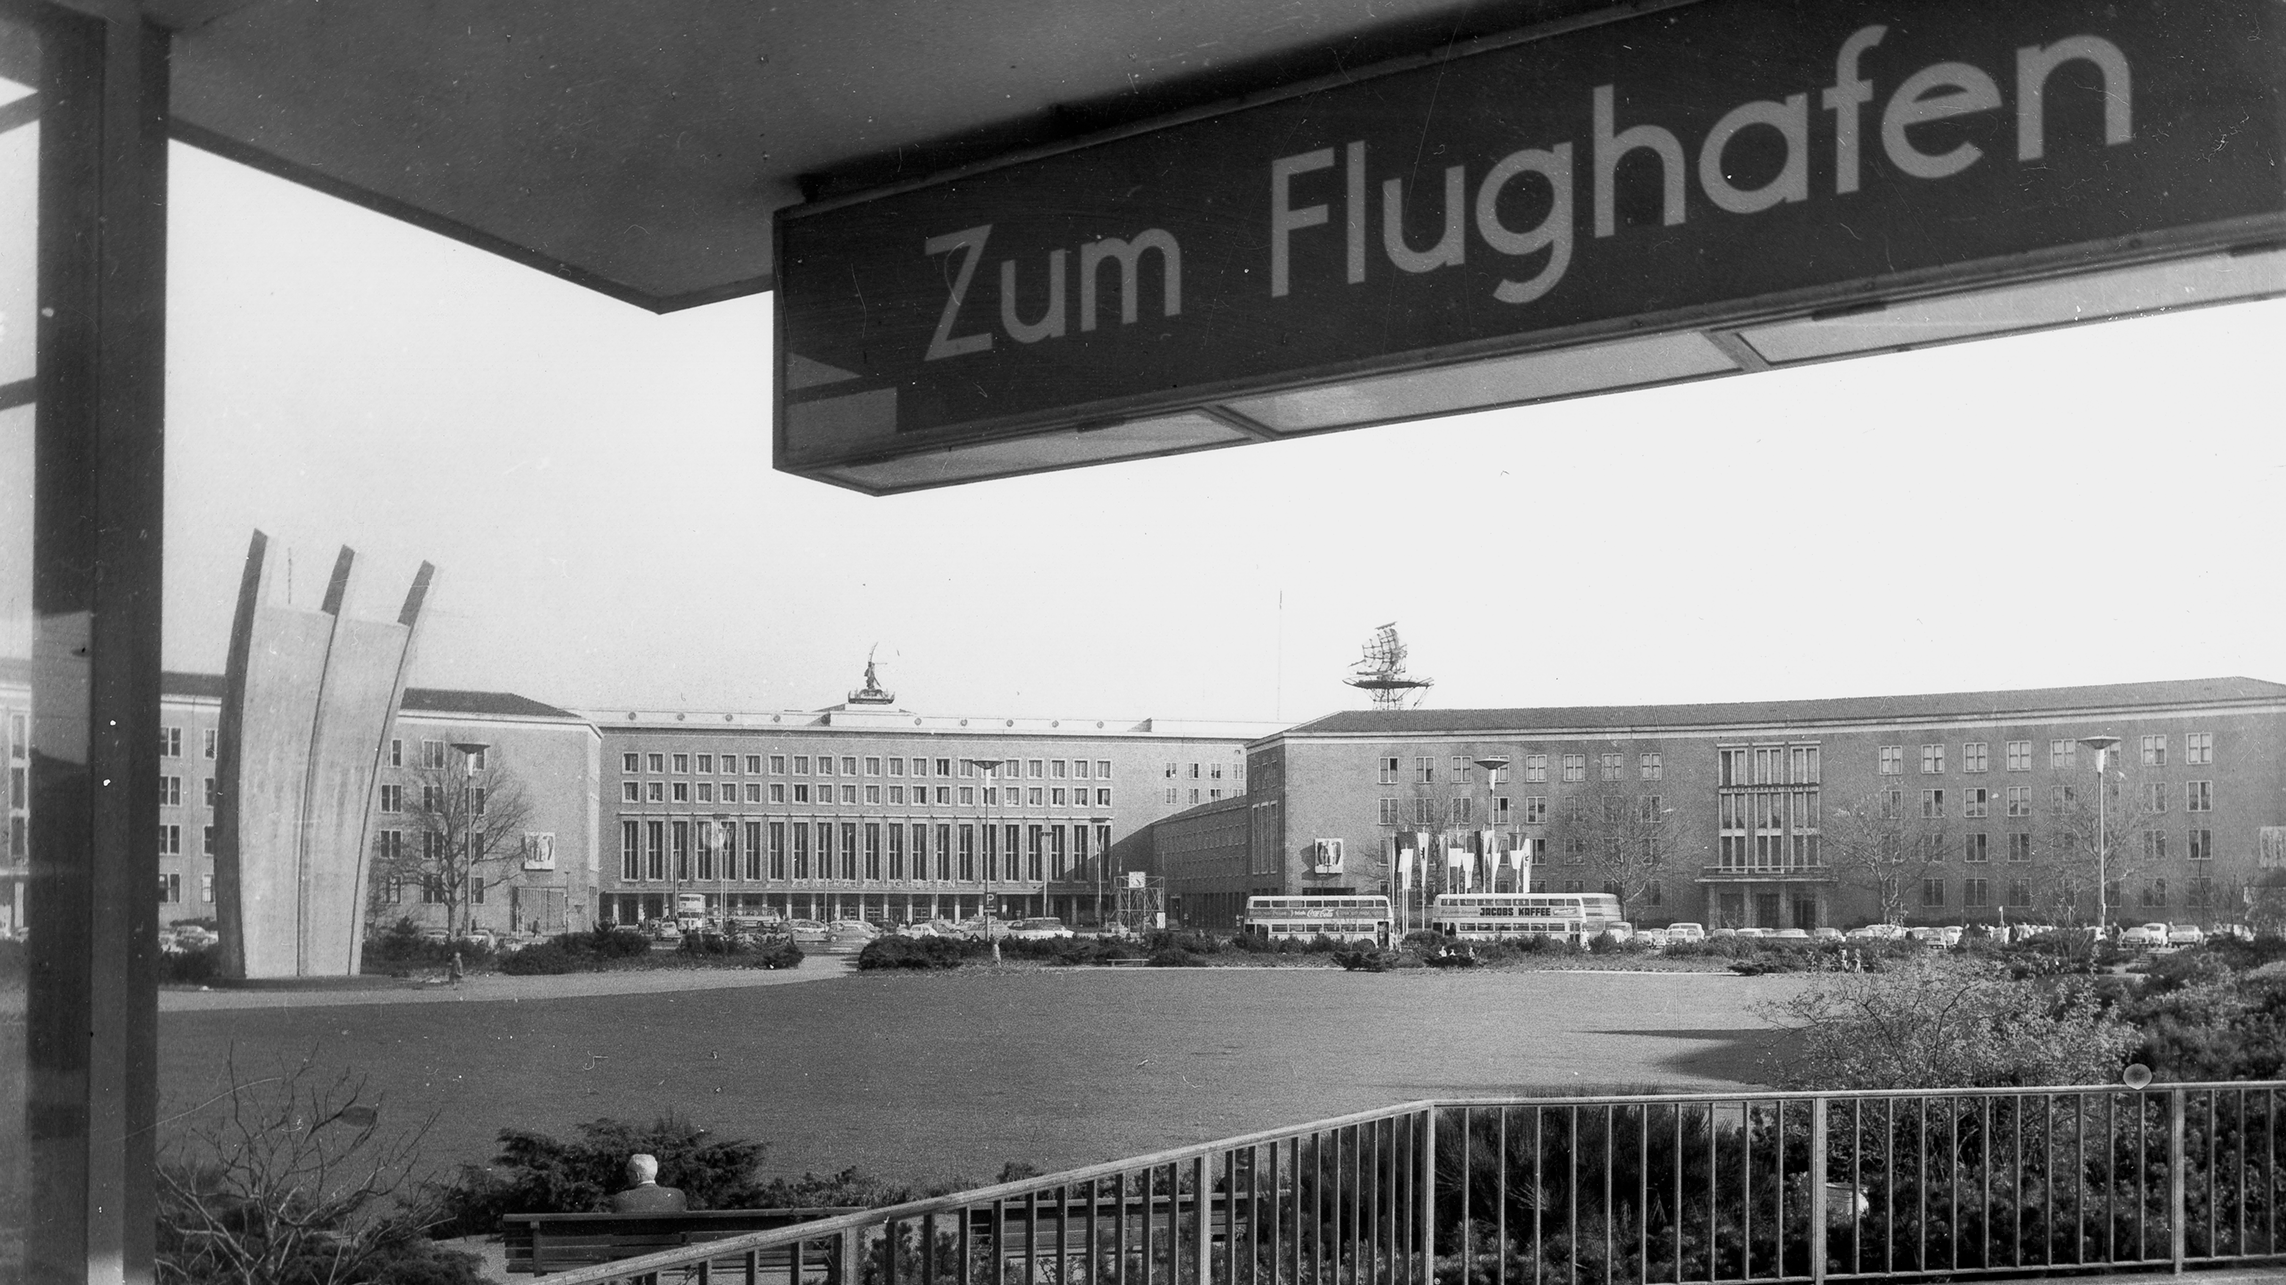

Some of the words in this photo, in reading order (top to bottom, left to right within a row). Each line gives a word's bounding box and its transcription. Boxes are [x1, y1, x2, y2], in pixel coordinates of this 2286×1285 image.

[924, 223, 1181, 361] Zum
[1271, 26, 2134, 305] Flughafen
[791, 879, 956, 888] ZENTRALFLUGHAFEN
[986, 894, 995, 905] P
[1480, 907, 1514, 916] JACOBS
[1518, 907, 1551, 916] KAFFEE
